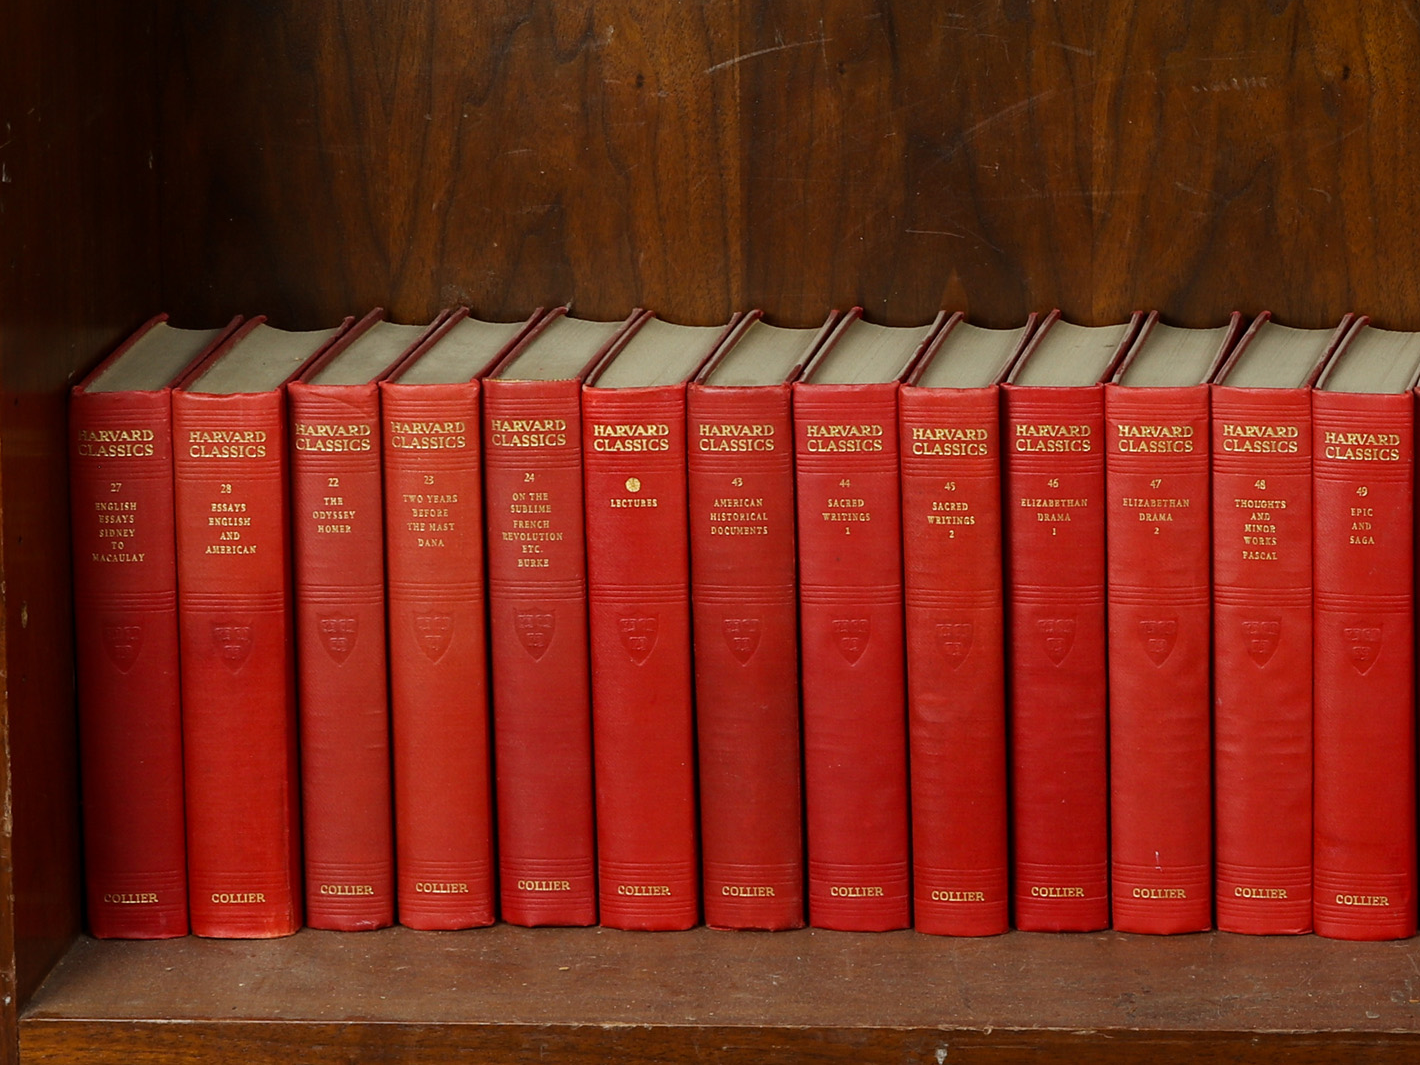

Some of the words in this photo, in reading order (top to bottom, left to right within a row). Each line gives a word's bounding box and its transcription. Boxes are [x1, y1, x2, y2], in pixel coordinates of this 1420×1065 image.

[492, 420, 566, 432] HARVARD
[699, 424, 774, 436] HARVARD
[1016, 424, 1091, 437] HARVARD
[189, 431, 266, 442] HARVARD
[492, 434, 566, 447] CLASSICS
[1325, 432, 1400, 445] HARVARD
[699, 439, 774, 451] CLASSICS
[1016, 439, 1091, 452] CLASSICS
[190, 445, 266, 458] CLASSICS
[1325, 446, 1399, 461] CLASSICS
[524, 473, 535, 482] 24
[732, 478, 743, 486] 43
[1048, 478, 1059, 488] 46
[221, 484, 232, 493] 28
[1356, 487, 1368, 496] 49
[512, 493, 525, 501] ON
[529, 493, 548, 501] THE
[714, 498, 763, 507] AMERICAN
[1021, 498, 1087, 507] ELIZABETHAN
[211, 503, 246, 512] ESSAYS
[511, 505, 551, 513] SUBLIME
[1351, 508, 1373, 516] EPIC
[208, 517, 251, 526] ENGLISH
[710, 513, 768, 521] HISTORICAL
[1037, 513, 1071, 521] DRAMA
[513, 520, 549, 529] FRENCH
[1352, 522, 1371, 530] AND
[711, 526, 768, 535] DOCUMENTS
[220, 532, 240, 540] AND
[502, 532, 563, 541] REVOLUTION
[1350, 536, 1374, 544] SAGA
[205, 545, 256, 554] AMERICAN
[522, 545, 543, 553] ETC.
[518, 559, 549, 567] BURKE
[518, 880, 570, 890] COLLIER
[721, 885, 774, 896] COLLIER
[1031, 886, 1084, 897] COLLIER
[211, 892, 265, 903] COLLIER
[1335, 895, 1389, 906] COLLIER
